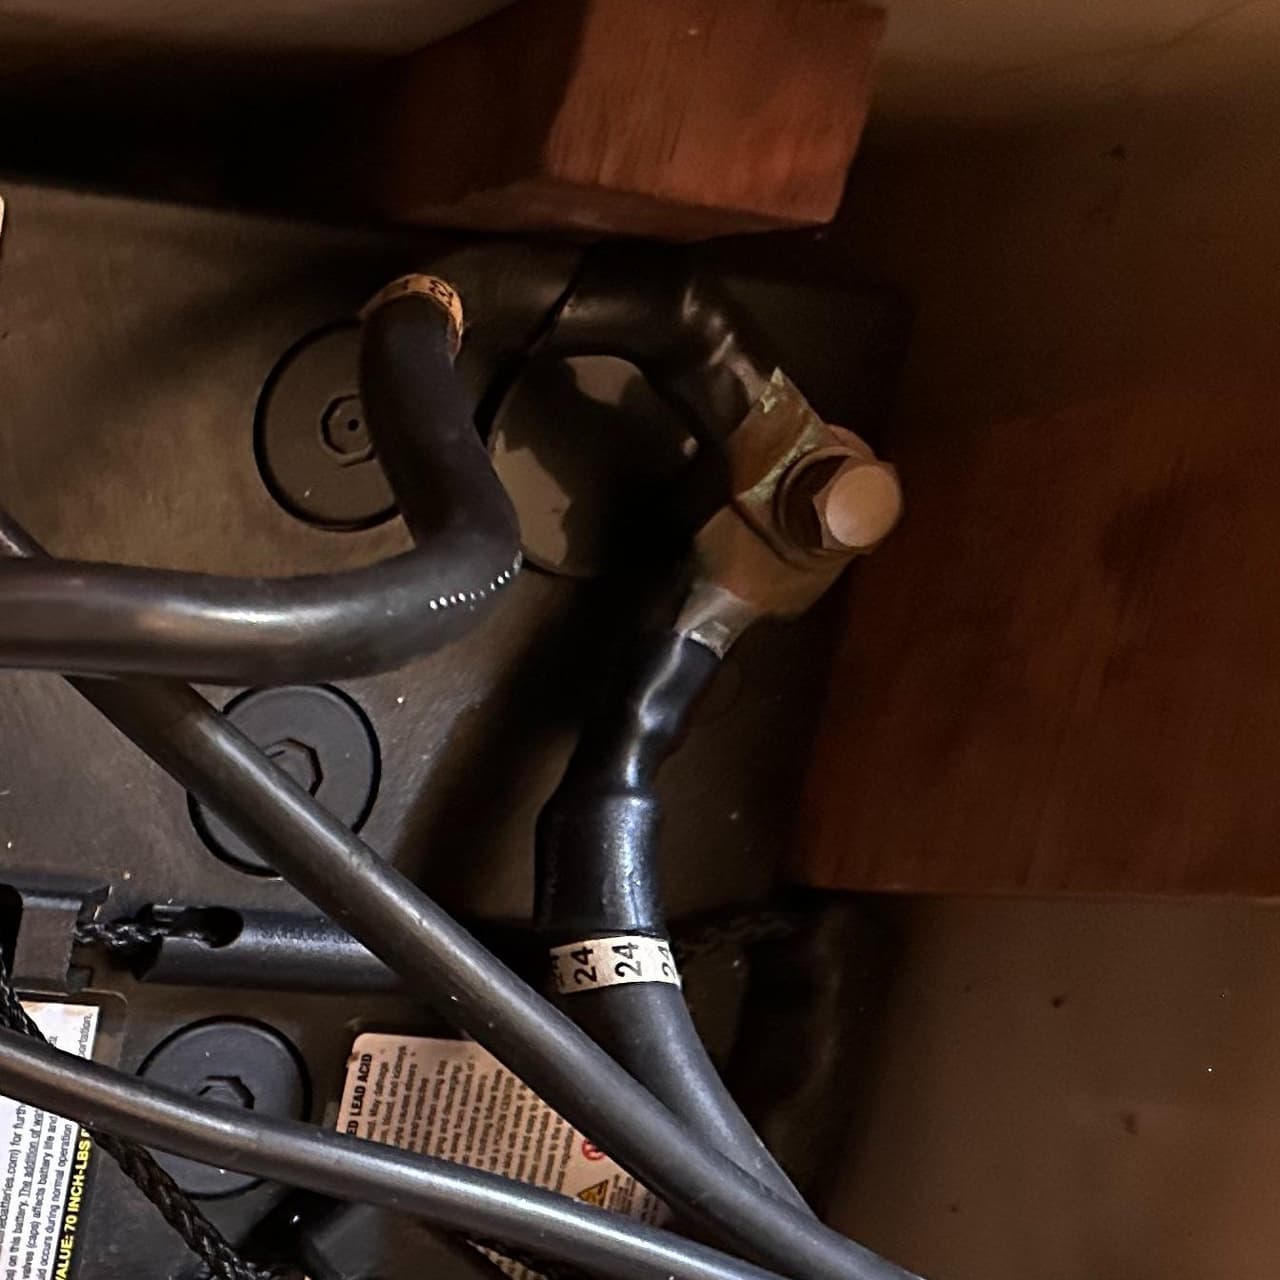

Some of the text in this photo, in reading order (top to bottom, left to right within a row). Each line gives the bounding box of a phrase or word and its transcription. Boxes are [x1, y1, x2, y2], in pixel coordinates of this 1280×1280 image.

[571, 945, 596, 985] 24
[612, 942, 642, 978] 24
[356, 1052, 373, 1082] ACID
[350, 1084, 366, 1116] LEAD
[56, 1123, 73, 1167] operation
[67, 1138, 91, 1212] INCH-LBS
[63, 1212, 77, 1232] 70
